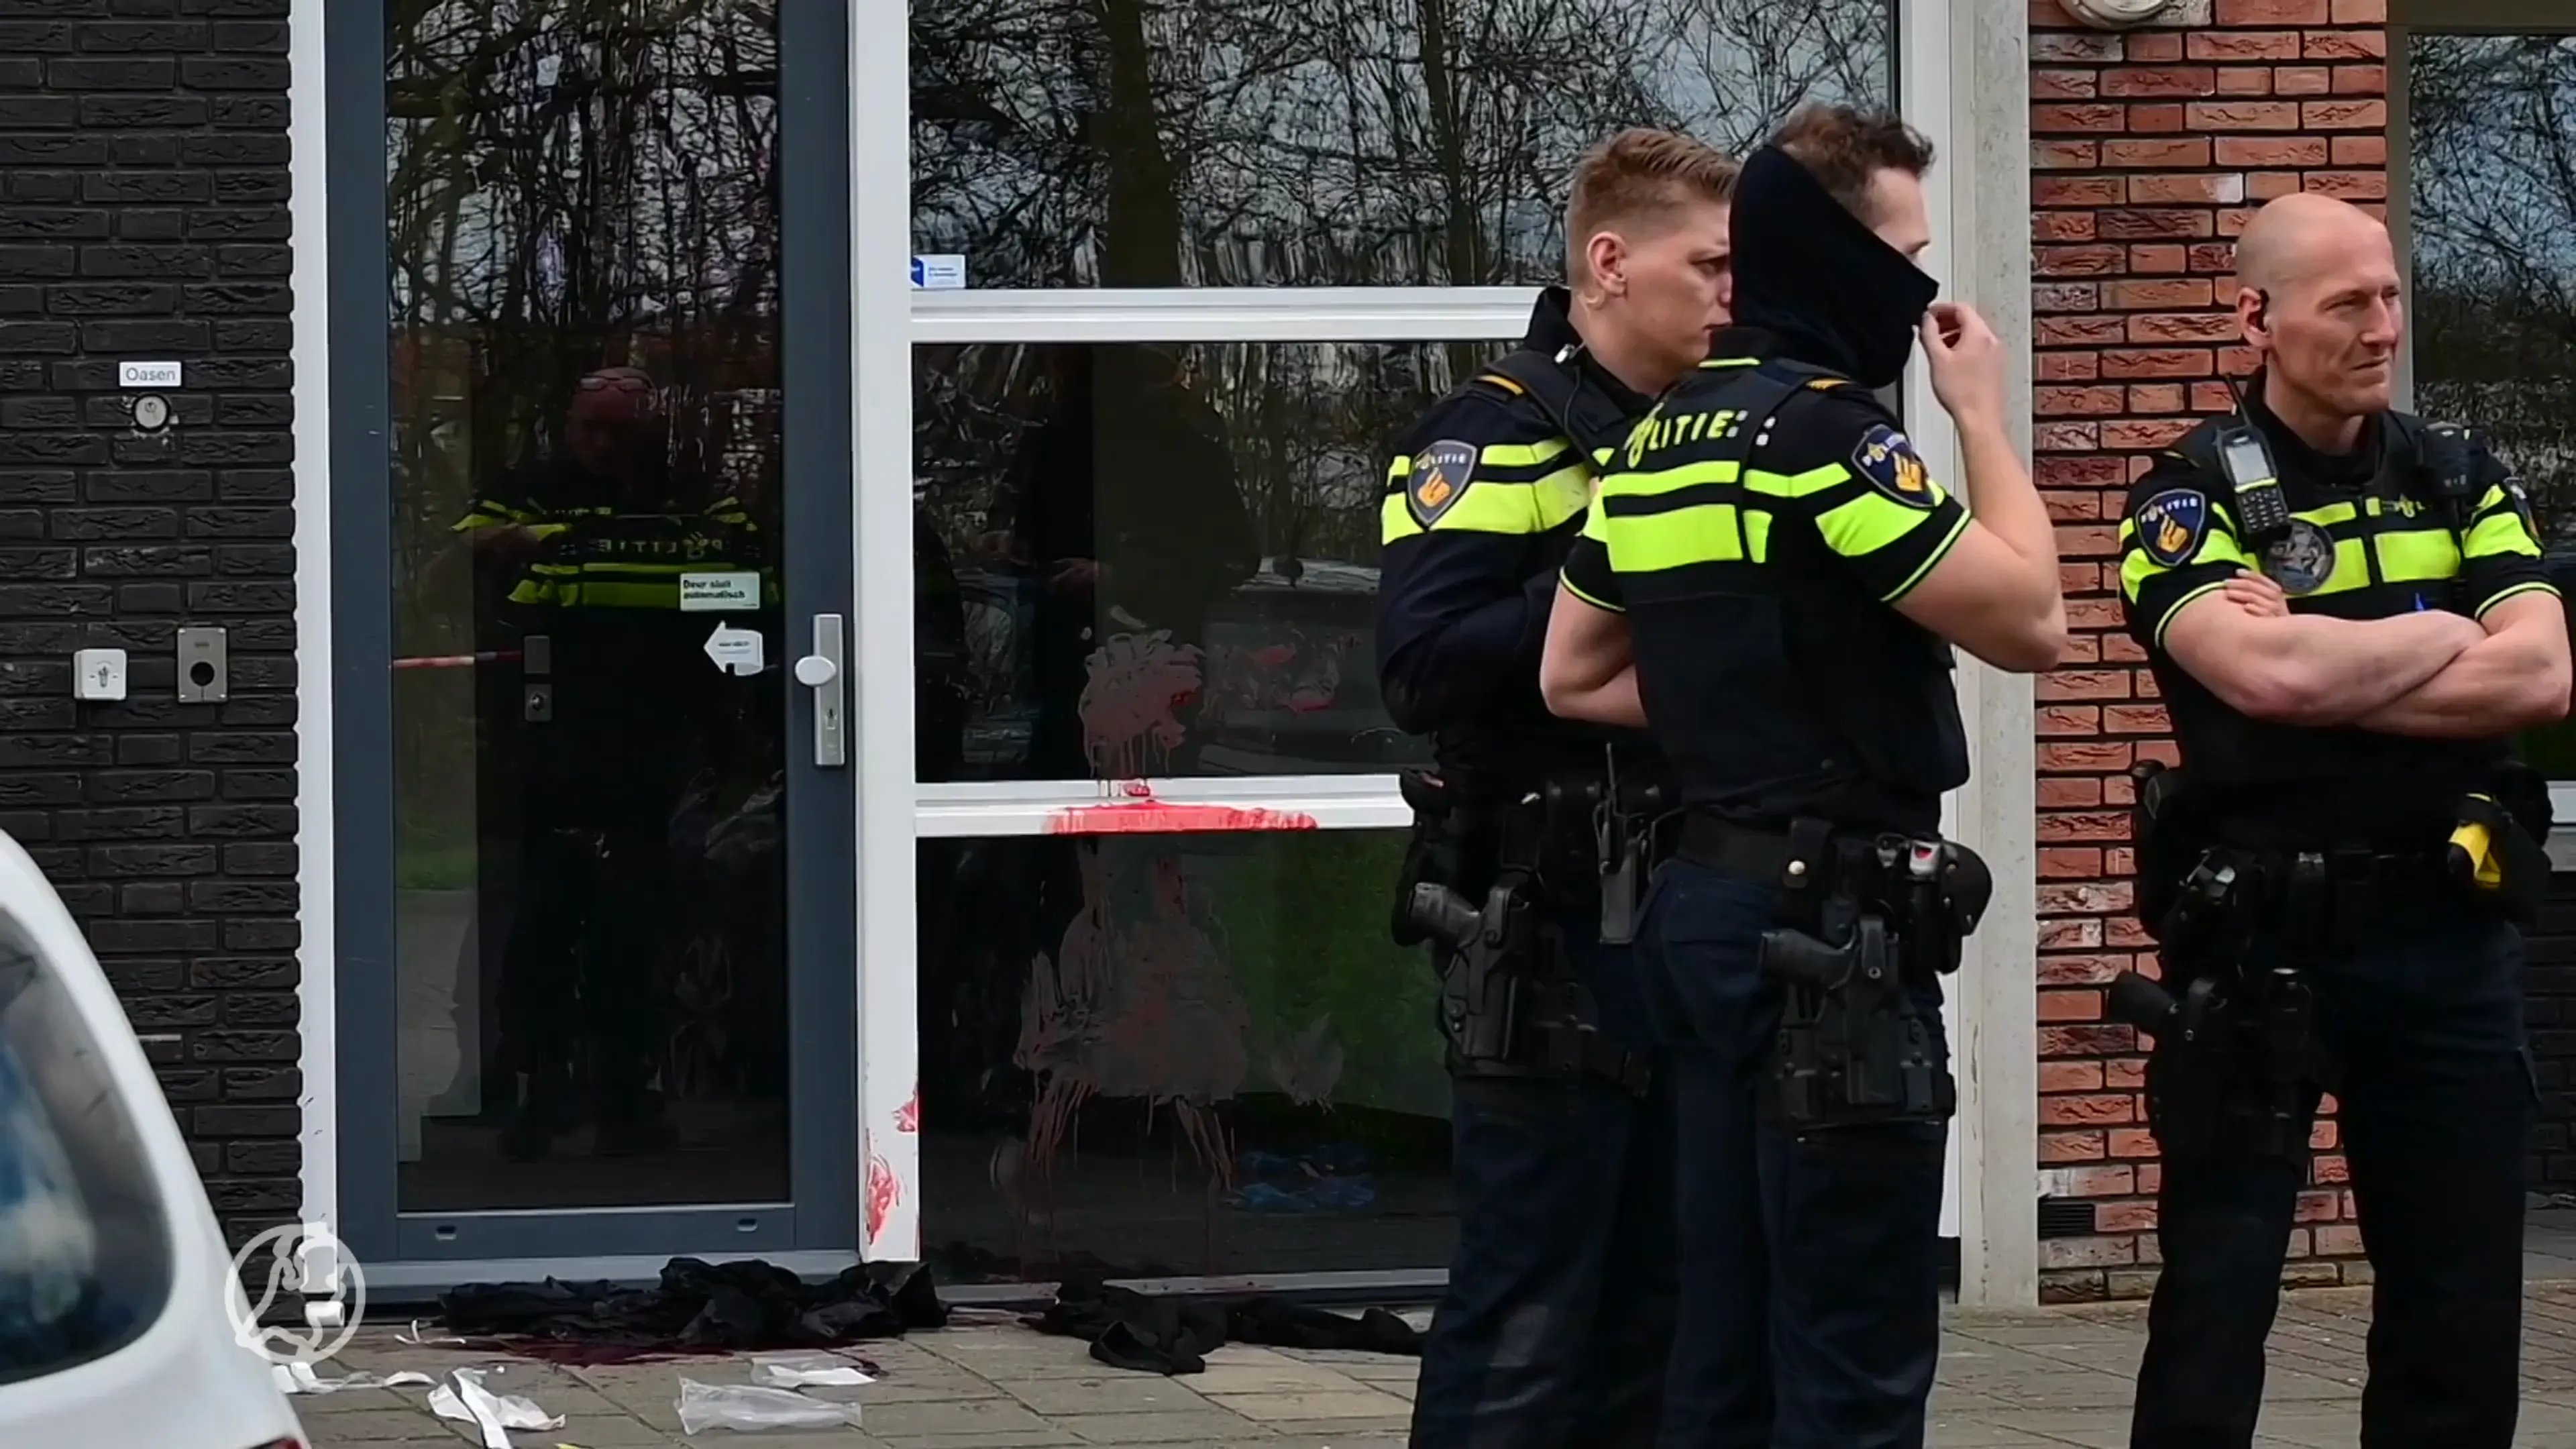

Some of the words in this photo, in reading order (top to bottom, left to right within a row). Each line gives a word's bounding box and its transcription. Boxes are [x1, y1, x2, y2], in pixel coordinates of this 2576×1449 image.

[125, 367, 176, 381] Oasen
[683, 579, 706, 588] Deur
[710, 579, 731, 588] sluit
[683, 590, 745, 599] automatisch
